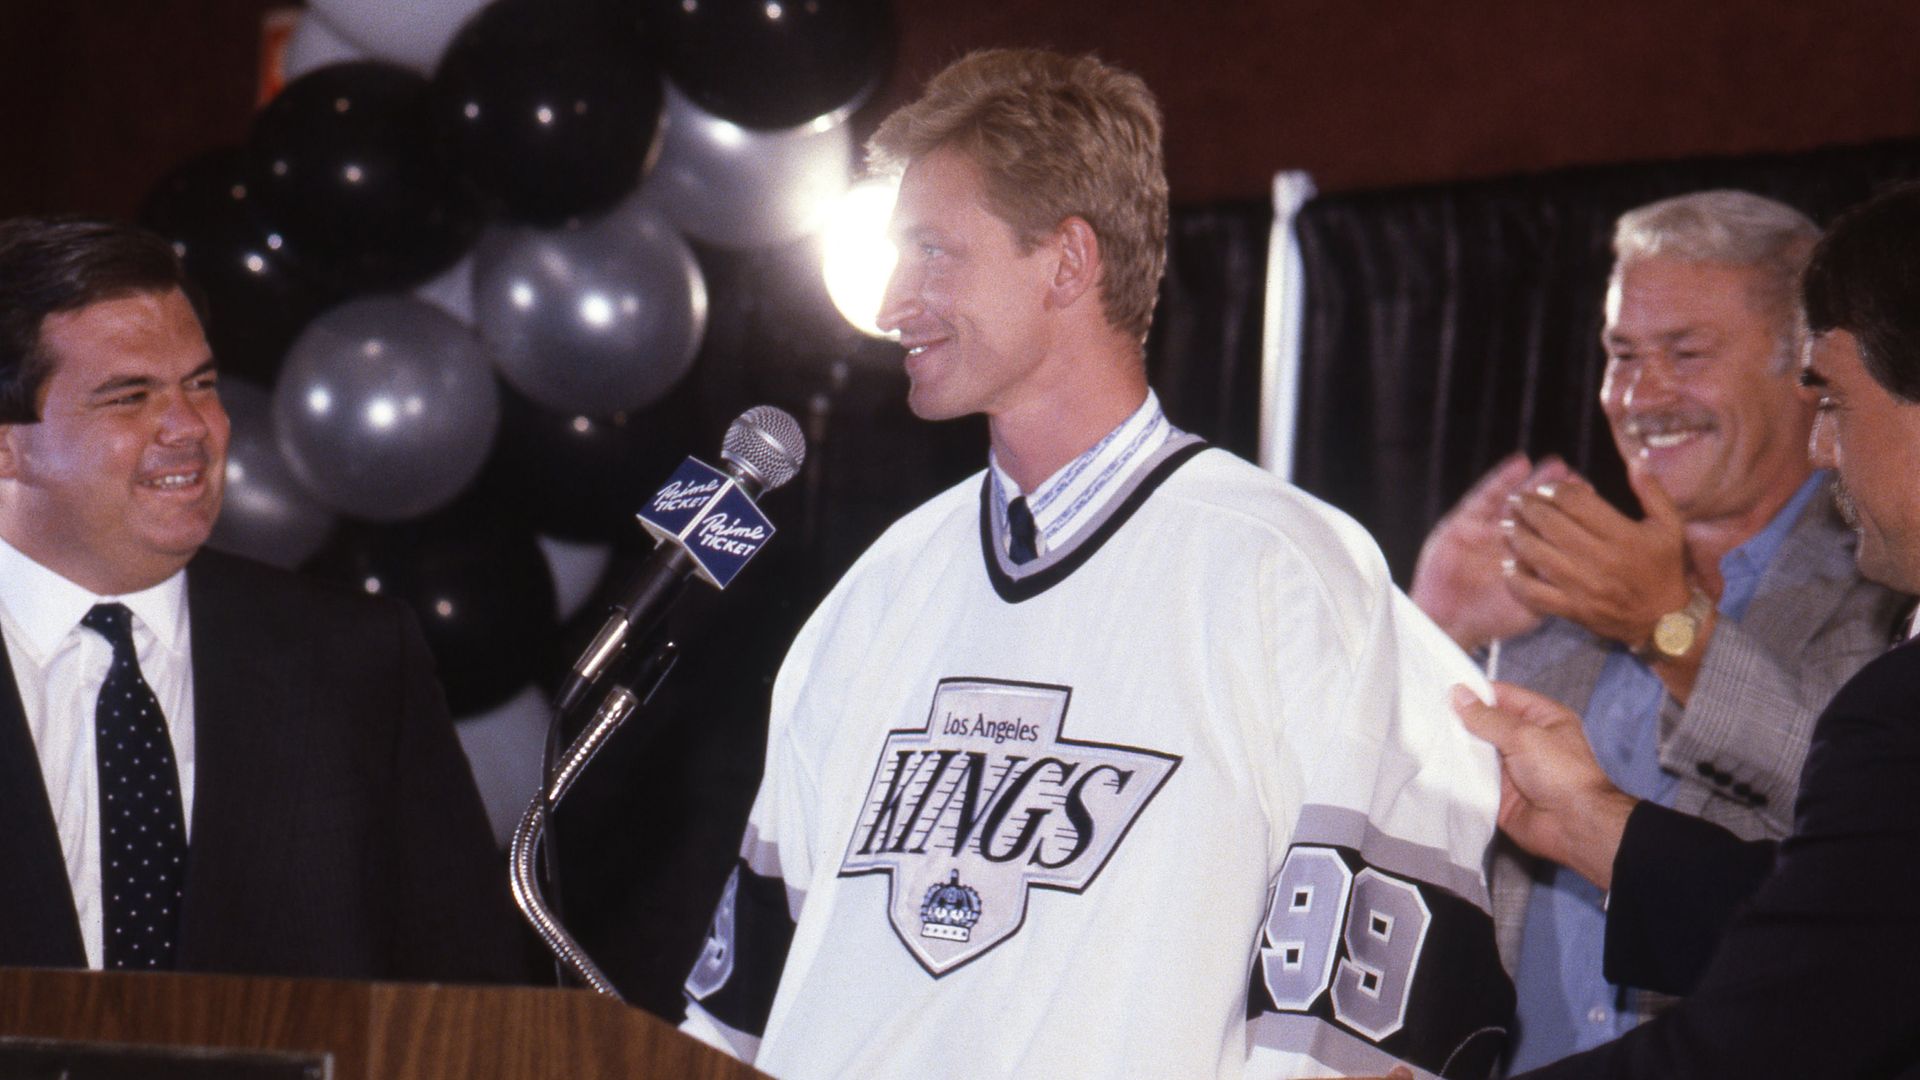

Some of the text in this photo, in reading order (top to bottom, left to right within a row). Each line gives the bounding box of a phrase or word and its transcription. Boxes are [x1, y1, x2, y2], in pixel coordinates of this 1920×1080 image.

[653, 479, 720, 506] Prime
[655, 496, 711, 511] TICKET
[698, 513, 765, 539] Prime
[700, 534, 756, 556] TICKET
[943, 711, 1040, 744] Los Angeles
[856, 749, 1134, 869] KINGS
[1260, 846, 1432, 1043] 99
